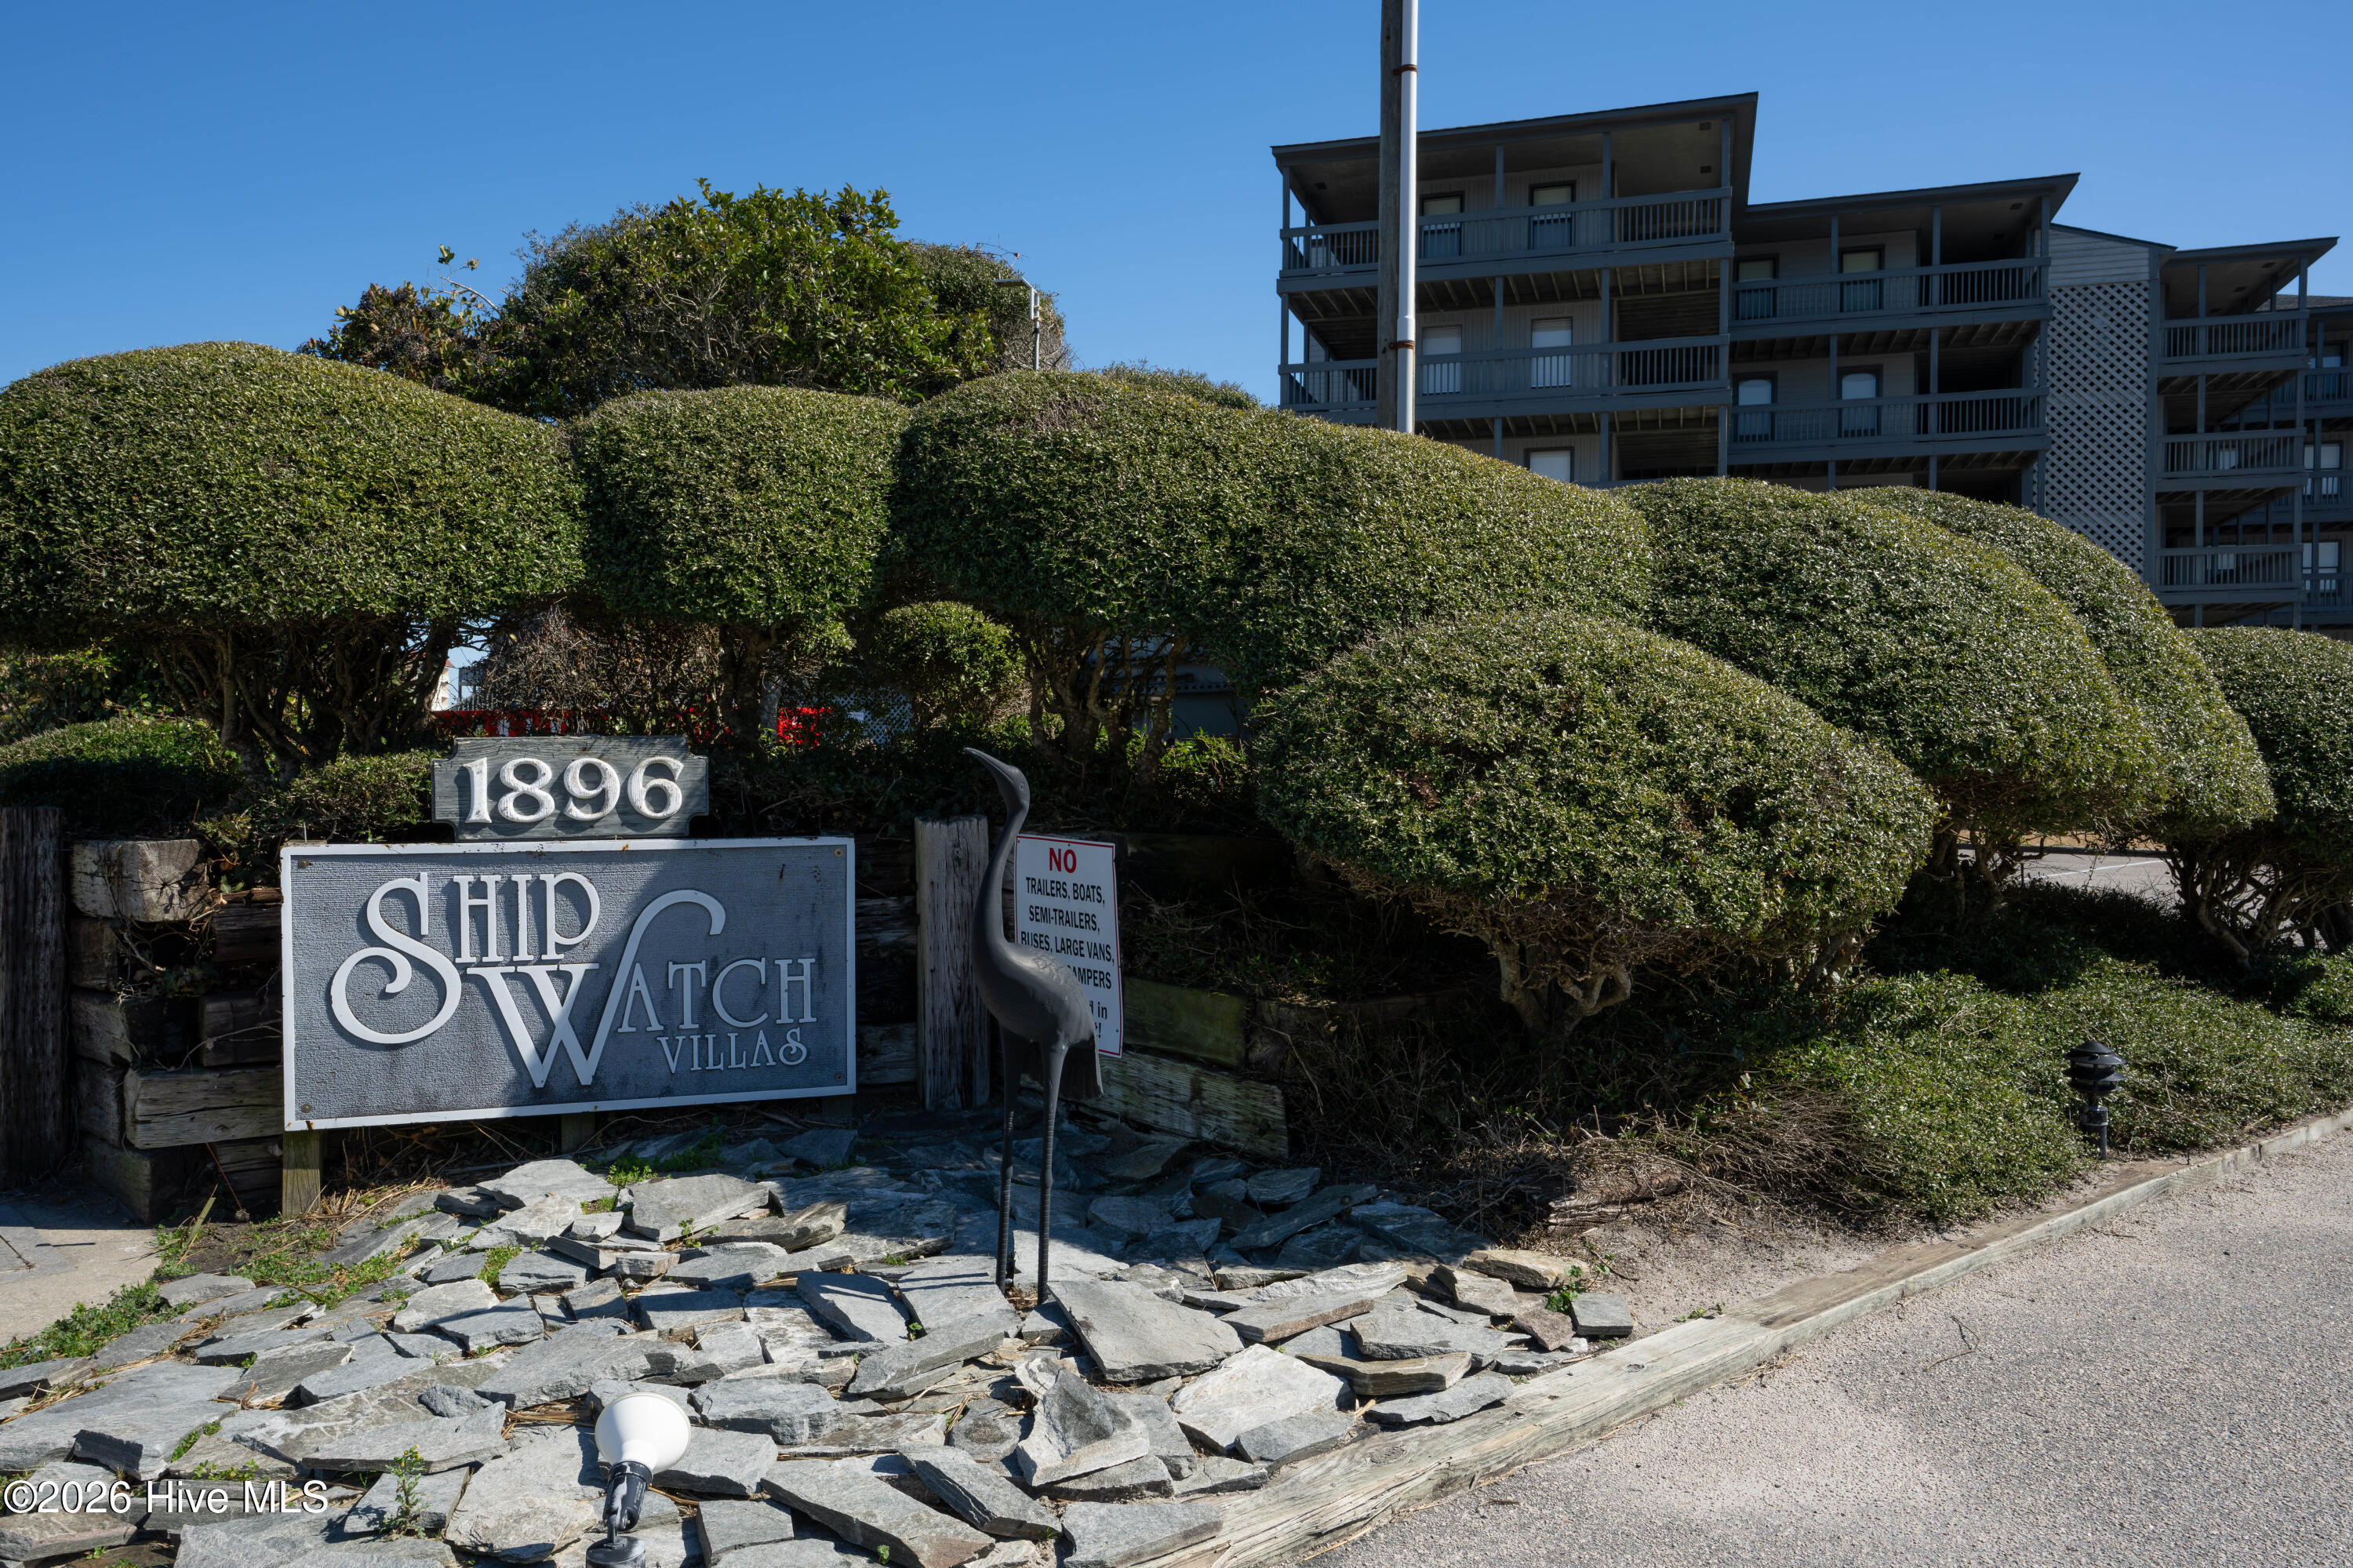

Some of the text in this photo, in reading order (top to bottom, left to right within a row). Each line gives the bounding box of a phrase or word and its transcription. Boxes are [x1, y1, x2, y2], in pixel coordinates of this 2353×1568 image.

[464, 756, 685, 824] 1896
[1049, 847, 1077, 873] NO
[1026, 876, 1105, 908] TRAILERS, BOATS,
[1029, 904, 1100, 935] SEMI-TRAILERS,
[330, 871, 601, 1045] SHIP
[1054, 936, 1086, 958] LARGE
[1086, 941, 1115, 966] VANS,
[466, 889, 817, 1089] WATCH
[1067, 965, 1111, 989] AMPERS
[656, 1028, 808, 1074] VILLAS
